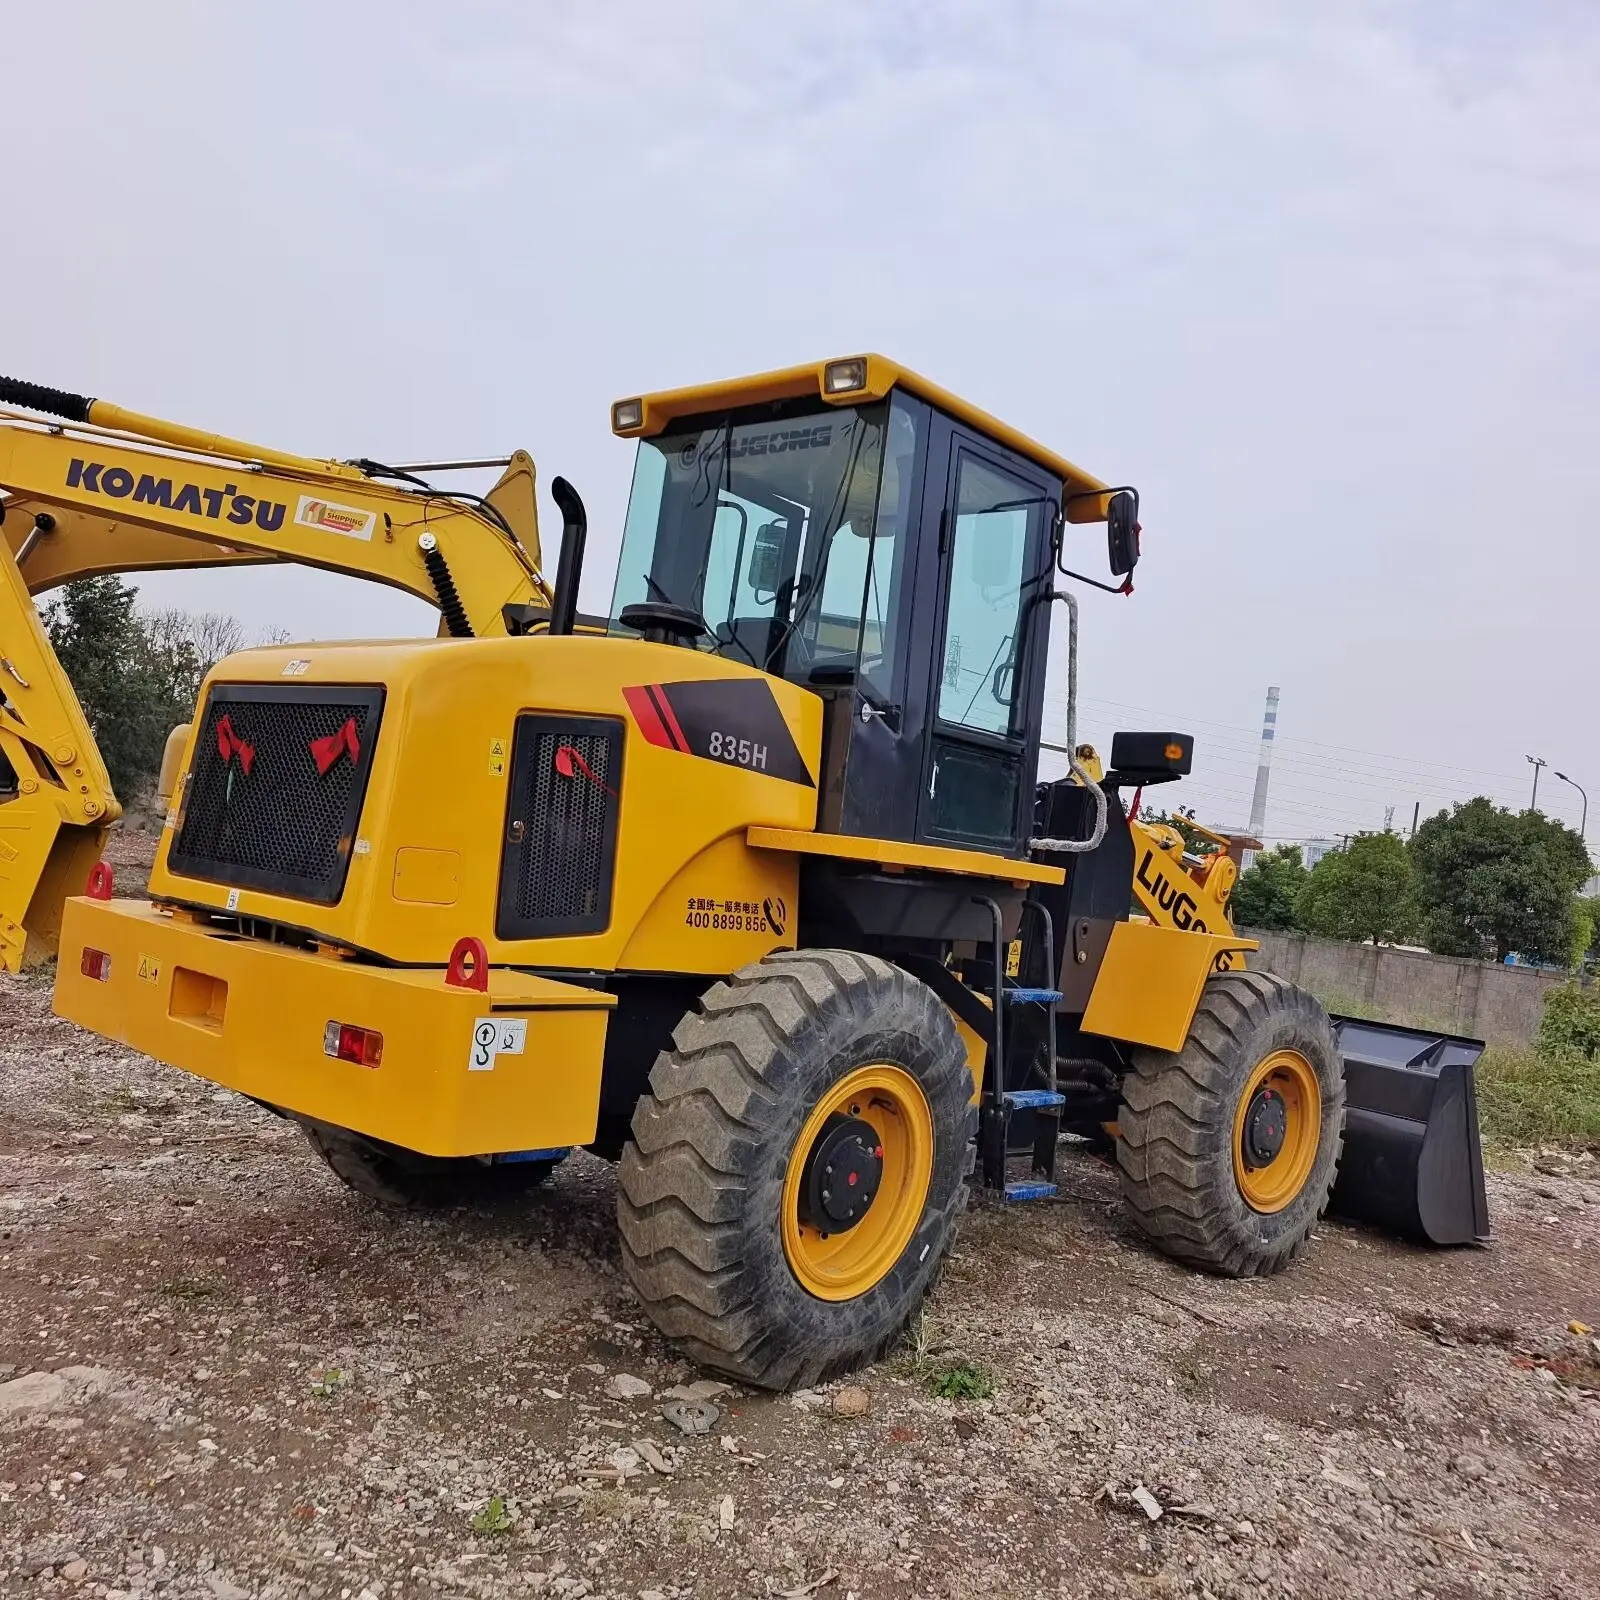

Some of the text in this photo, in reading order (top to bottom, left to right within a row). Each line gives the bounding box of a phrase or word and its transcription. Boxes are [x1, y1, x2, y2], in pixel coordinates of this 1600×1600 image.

[66, 458, 287, 531] KOMATSU
[327, 512, 364, 527] SHIPPING
[709, 731, 768, 769] 835H
[687, 897, 760, 915] 全国统一服务电话
[686, 911, 767, 933] 400 8899 856
